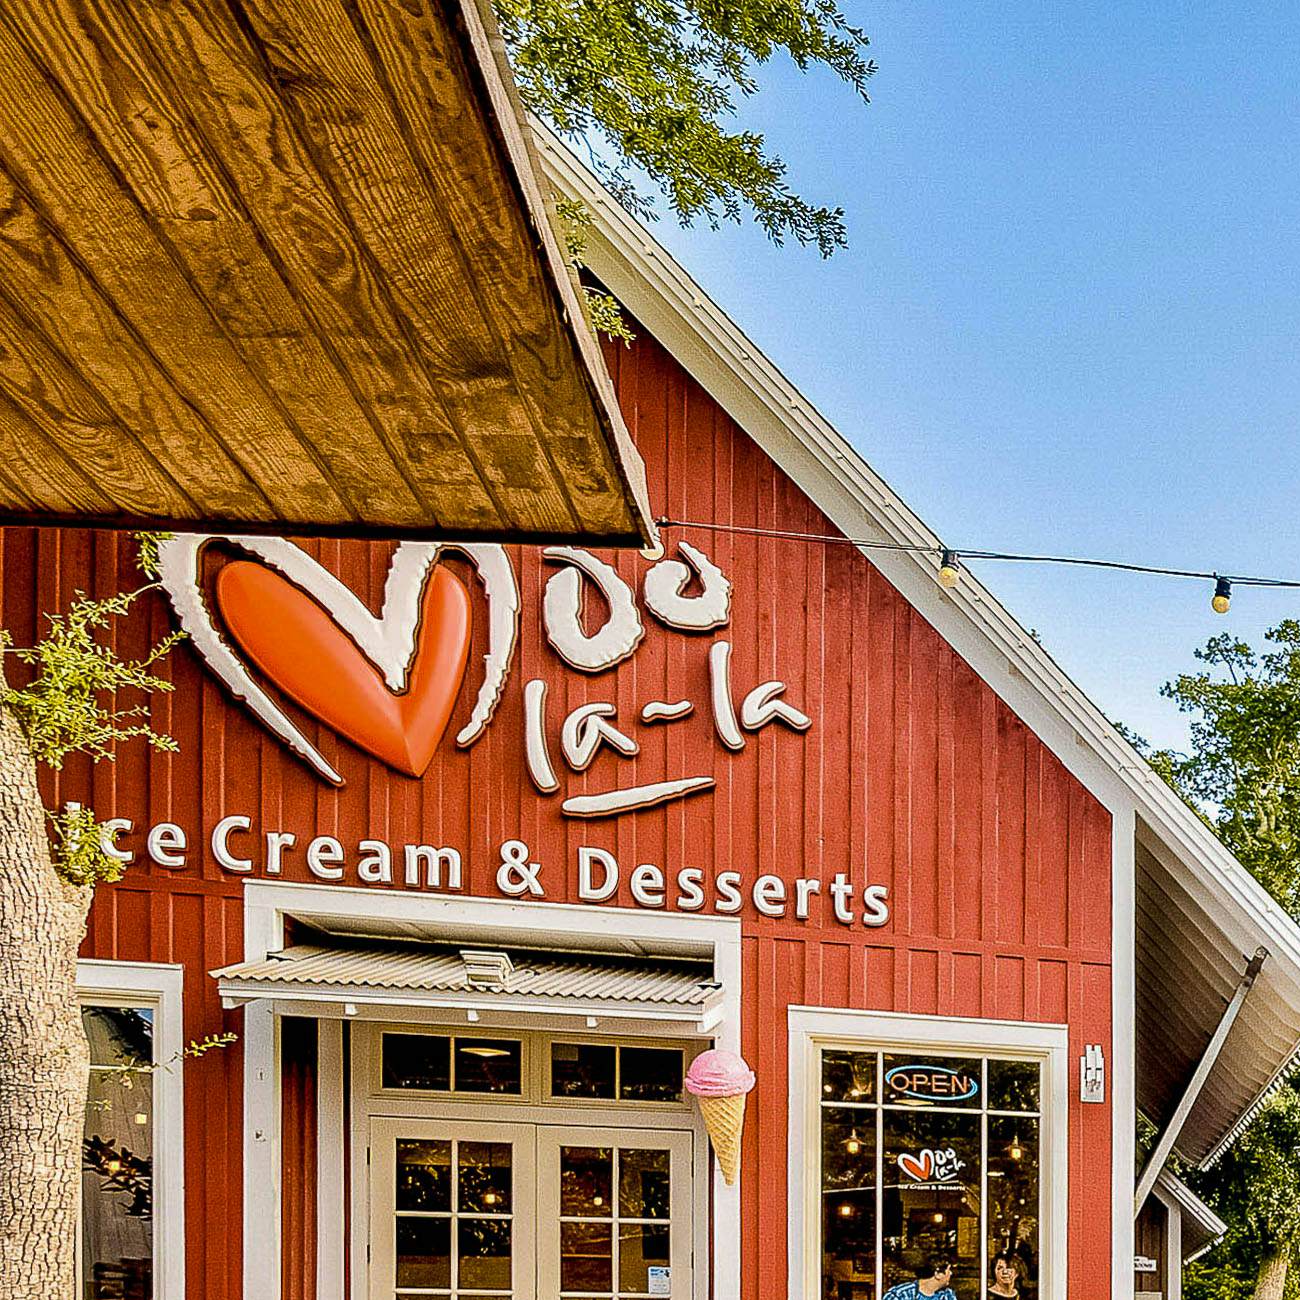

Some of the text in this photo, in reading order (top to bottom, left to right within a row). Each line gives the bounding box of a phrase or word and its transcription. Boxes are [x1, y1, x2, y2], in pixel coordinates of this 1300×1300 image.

[524, 640, 812, 793] la-la
[212, 815, 462, 889] Cream
[496, 839, 545, 897] &
[578, 845, 890, 927] Desserts
[890, 1073, 968, 1094] OPEN
